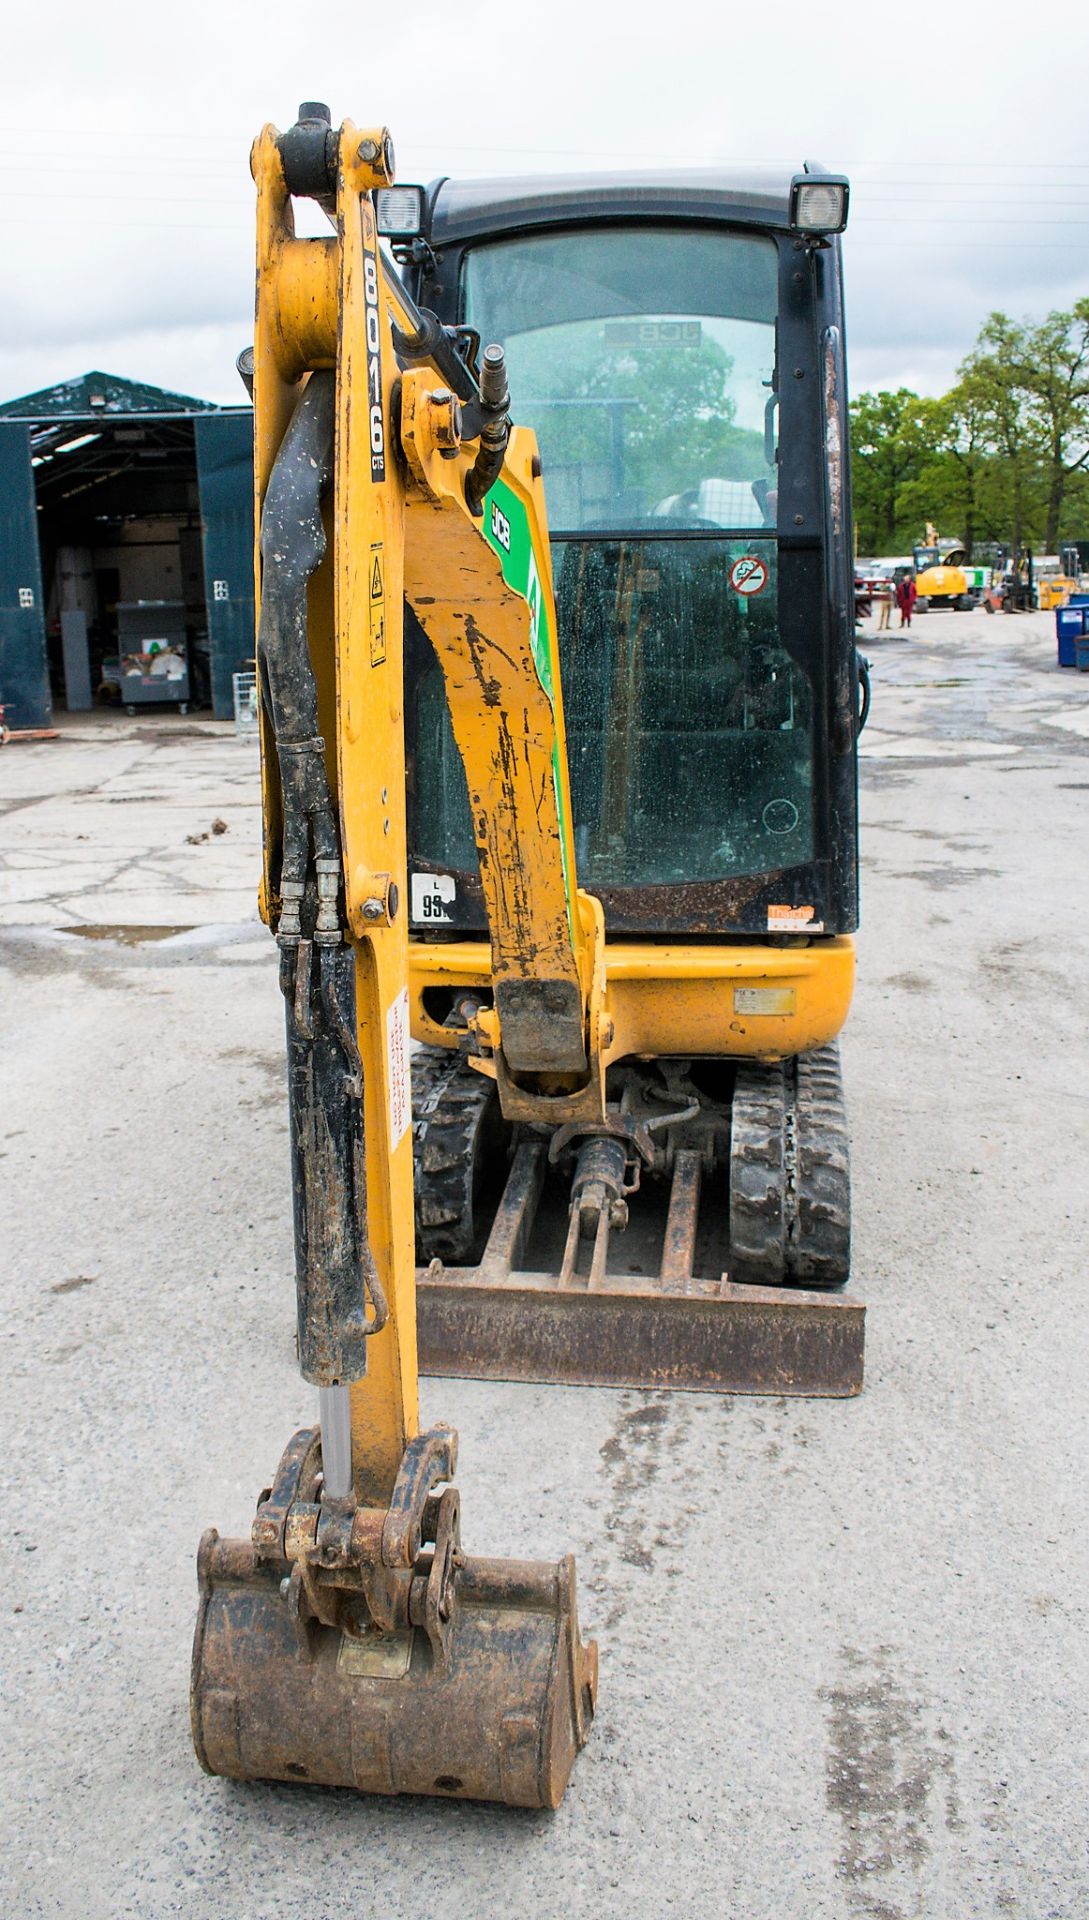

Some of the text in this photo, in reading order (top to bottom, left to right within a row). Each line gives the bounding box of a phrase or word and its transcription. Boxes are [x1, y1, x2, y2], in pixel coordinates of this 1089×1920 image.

[364, 256, 384, 454] 8016
[371, 455, 384, 470] CTS
[491, 501, 511, 551] JCB
[433, 881, 440, 890] L
